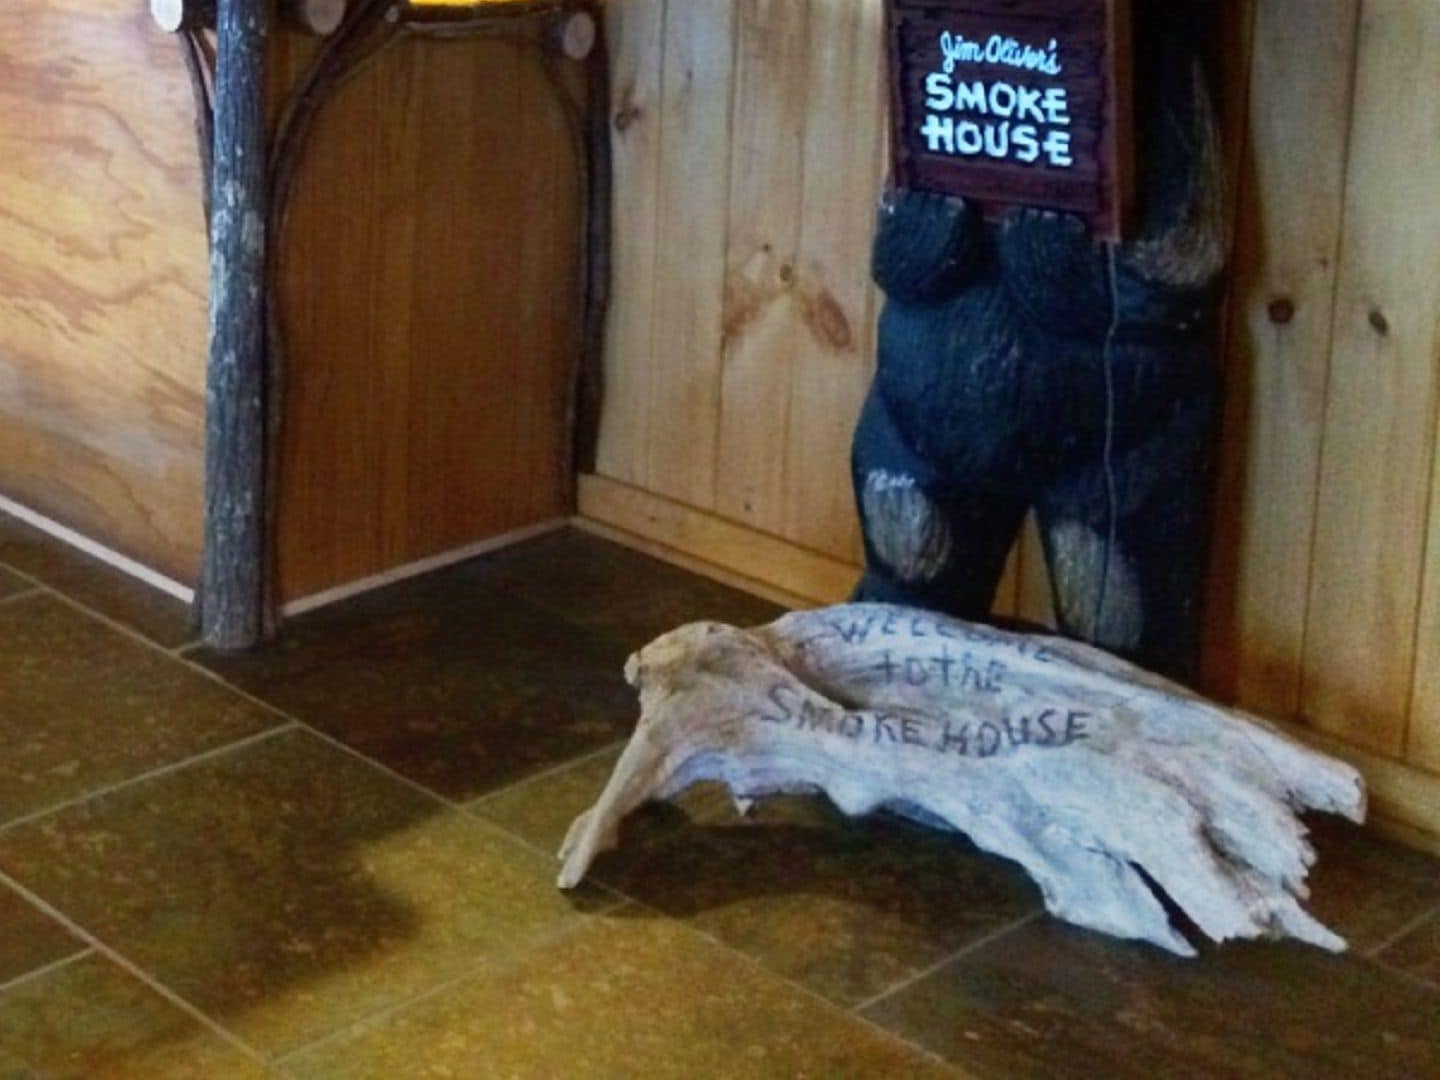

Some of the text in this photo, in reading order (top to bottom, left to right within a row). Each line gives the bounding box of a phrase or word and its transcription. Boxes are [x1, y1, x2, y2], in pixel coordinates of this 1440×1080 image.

[940, 31, 1061, 74] Jim Oliver's
[925, 73, 1070, 124] SMOKE
[920, 115, 1073, 167] HOUSE
[762, 685, 1090, 757] SMOKE HOUSE
